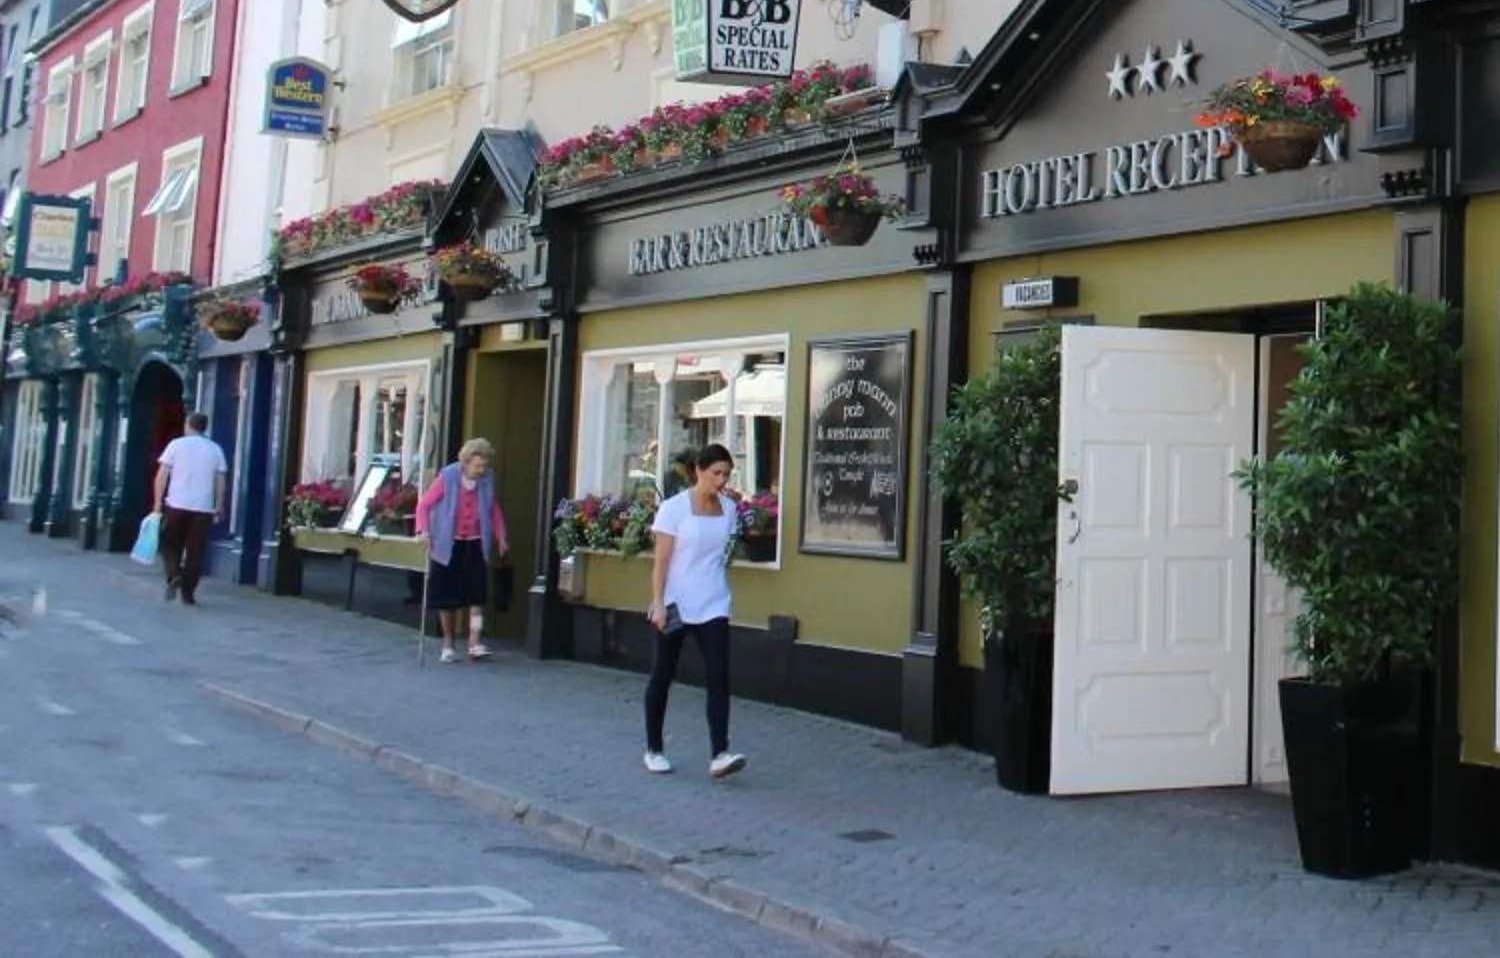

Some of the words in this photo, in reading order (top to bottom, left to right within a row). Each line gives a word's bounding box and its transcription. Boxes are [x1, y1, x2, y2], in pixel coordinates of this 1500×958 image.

[716, 24, 790, 50] SPECIAL
[724, 47, 781, 72] RATES
[981, 151, 1097, 219] HOTEL
[1104, 123, 1344, 199] RECEPTN
[628, 236, 665, 275] BAR
[667, 231, 688, 270] &
[689, 210, 831, 266] RESTAURAN
